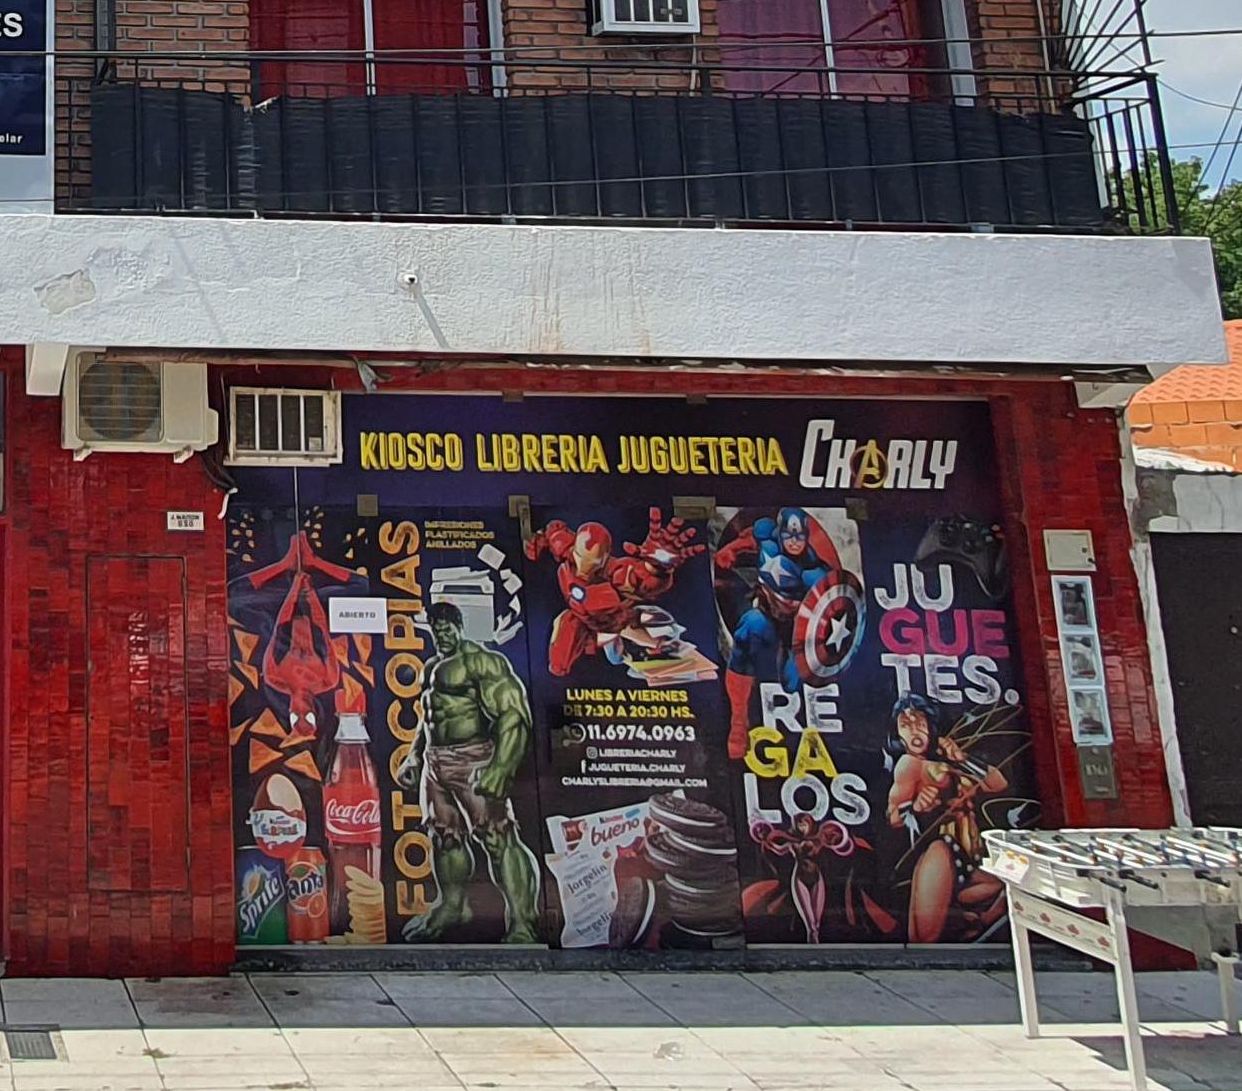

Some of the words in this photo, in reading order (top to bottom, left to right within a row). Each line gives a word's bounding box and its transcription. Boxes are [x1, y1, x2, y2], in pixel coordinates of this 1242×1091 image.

[360, 432, 464, 471] KIOSCO
[476, 433, 610, 473] LIBRERIA
[617, 435, 789, 475] JUGUETERIA
[799, 419, 958, 489] CHARLY
[425, 530, 495, 539] PLASTIFICADOS
[425, 540, 477, 549] ANILLADOS
[874, 563, 954, 612] JU
[338, 611, 376, 619] ABIERTO
[879, 607, 1010, 659] GUE
[566, 688, 613, 701] LUNES
[615, 690, 626, 701] A
[628, 690, 688, 702] VIERNES
[881, 653, 1020, 705] TES.
[585, 705, 614, 717] 7:30
[616, 706, 628, 717] A
[629, 705, 668, 718] 20:30
[671, 706, 695, 718] HS.
[759, 682, 843, 733] RE
[587, 724, 696, 741] 11.6974.0963
[599, 748, 677, 758] LIBRERIACHARLY
[744, 726, 838, 779] GA
[743, 773, 870, 825] LOS
[590, 818, 640, 847] bueno
[240, 877, 280, 933] Sprite
